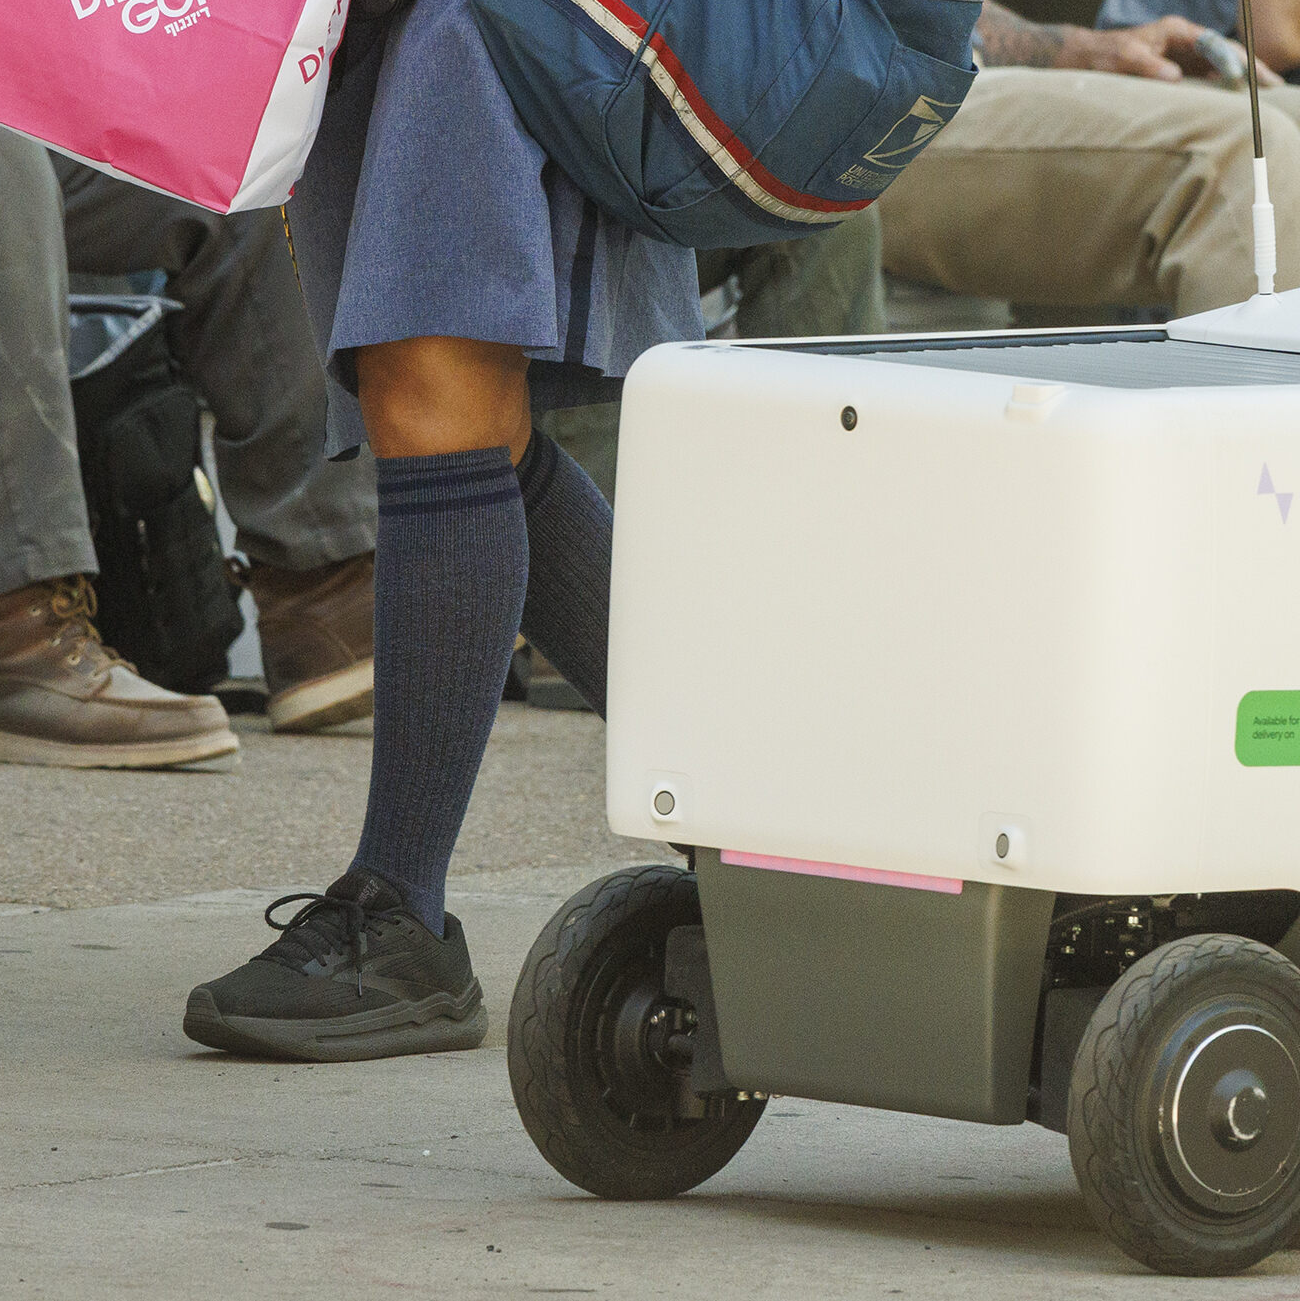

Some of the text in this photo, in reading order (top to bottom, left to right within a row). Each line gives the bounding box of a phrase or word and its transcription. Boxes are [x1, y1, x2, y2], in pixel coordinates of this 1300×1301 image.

[1253, 715, 1300, 726] Available for
[1251, 730, 1295, 741] delivery on
